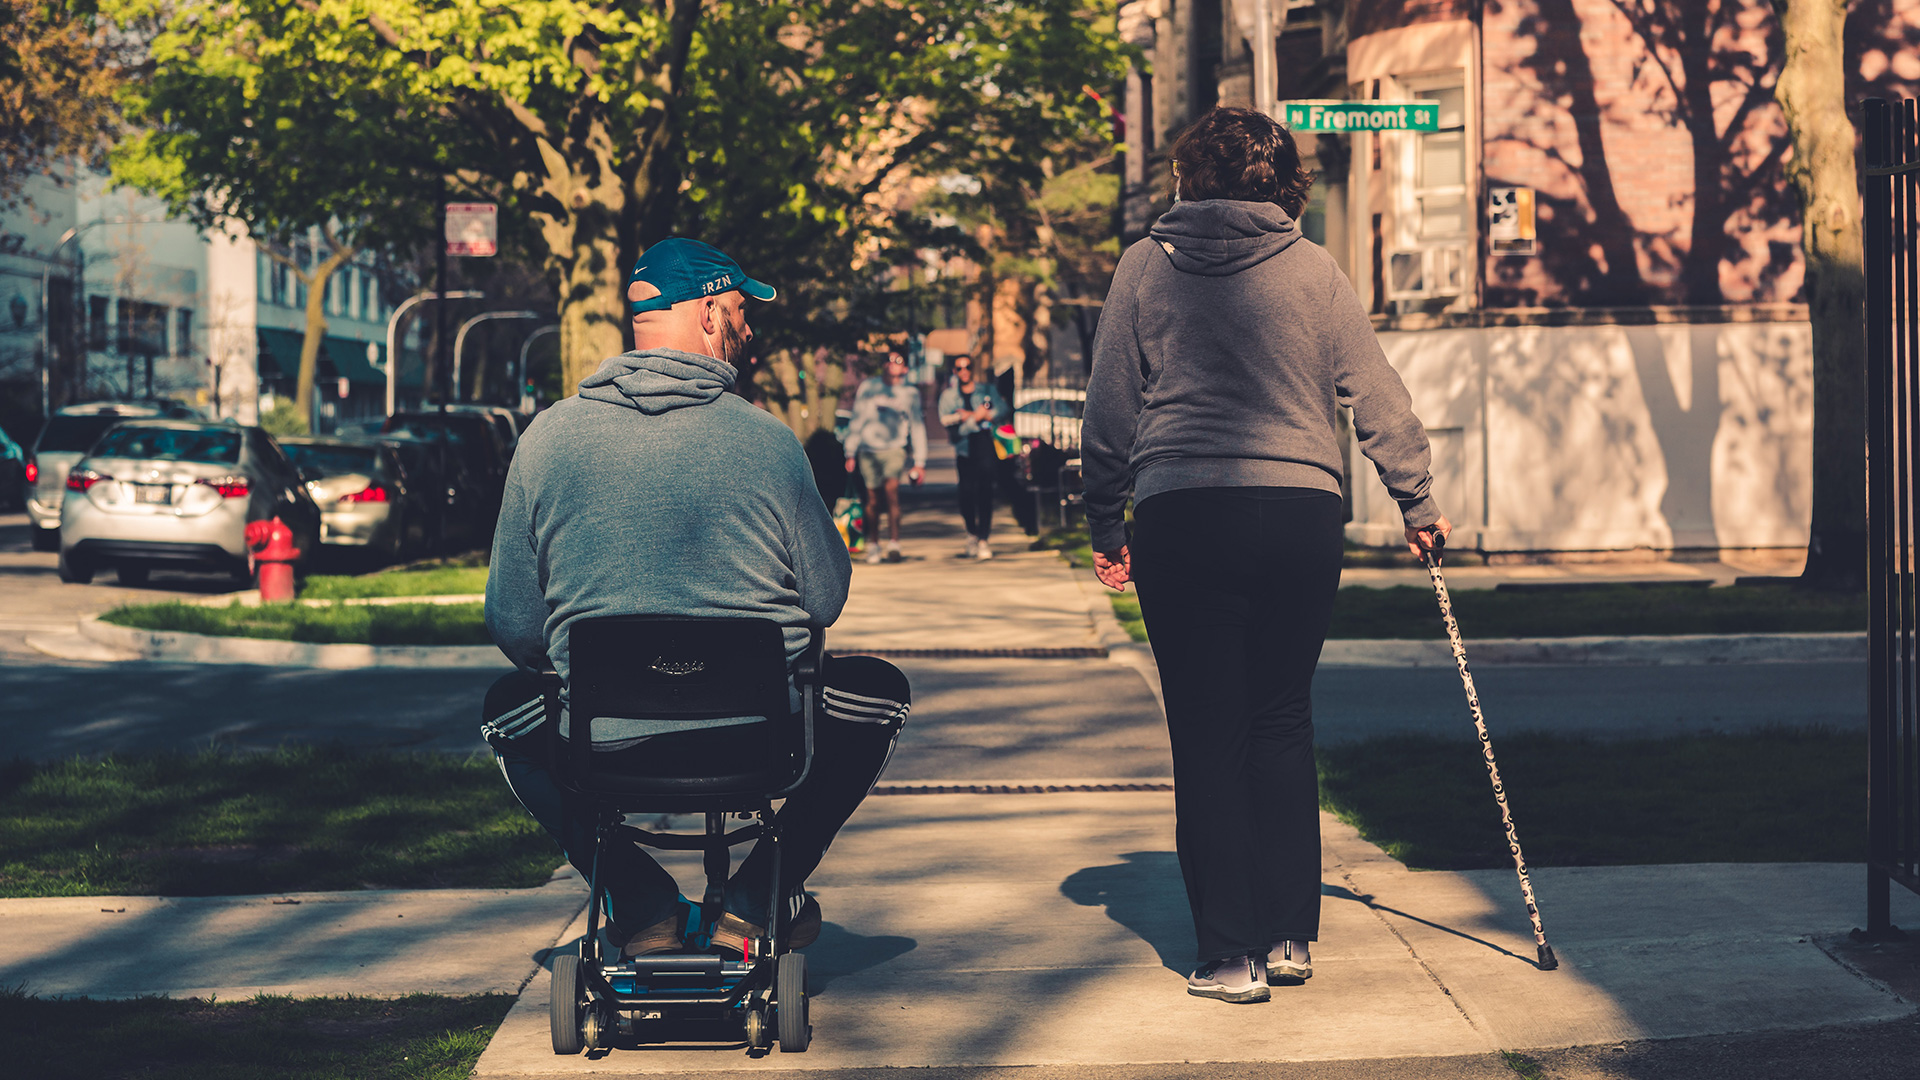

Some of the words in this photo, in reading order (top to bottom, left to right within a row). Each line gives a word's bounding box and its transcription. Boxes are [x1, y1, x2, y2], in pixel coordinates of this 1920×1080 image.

[1291, 110, 1304, 125] N
[1309, 105, 1408, 129] Fremont
[1414, 109, 1431, 125] St
